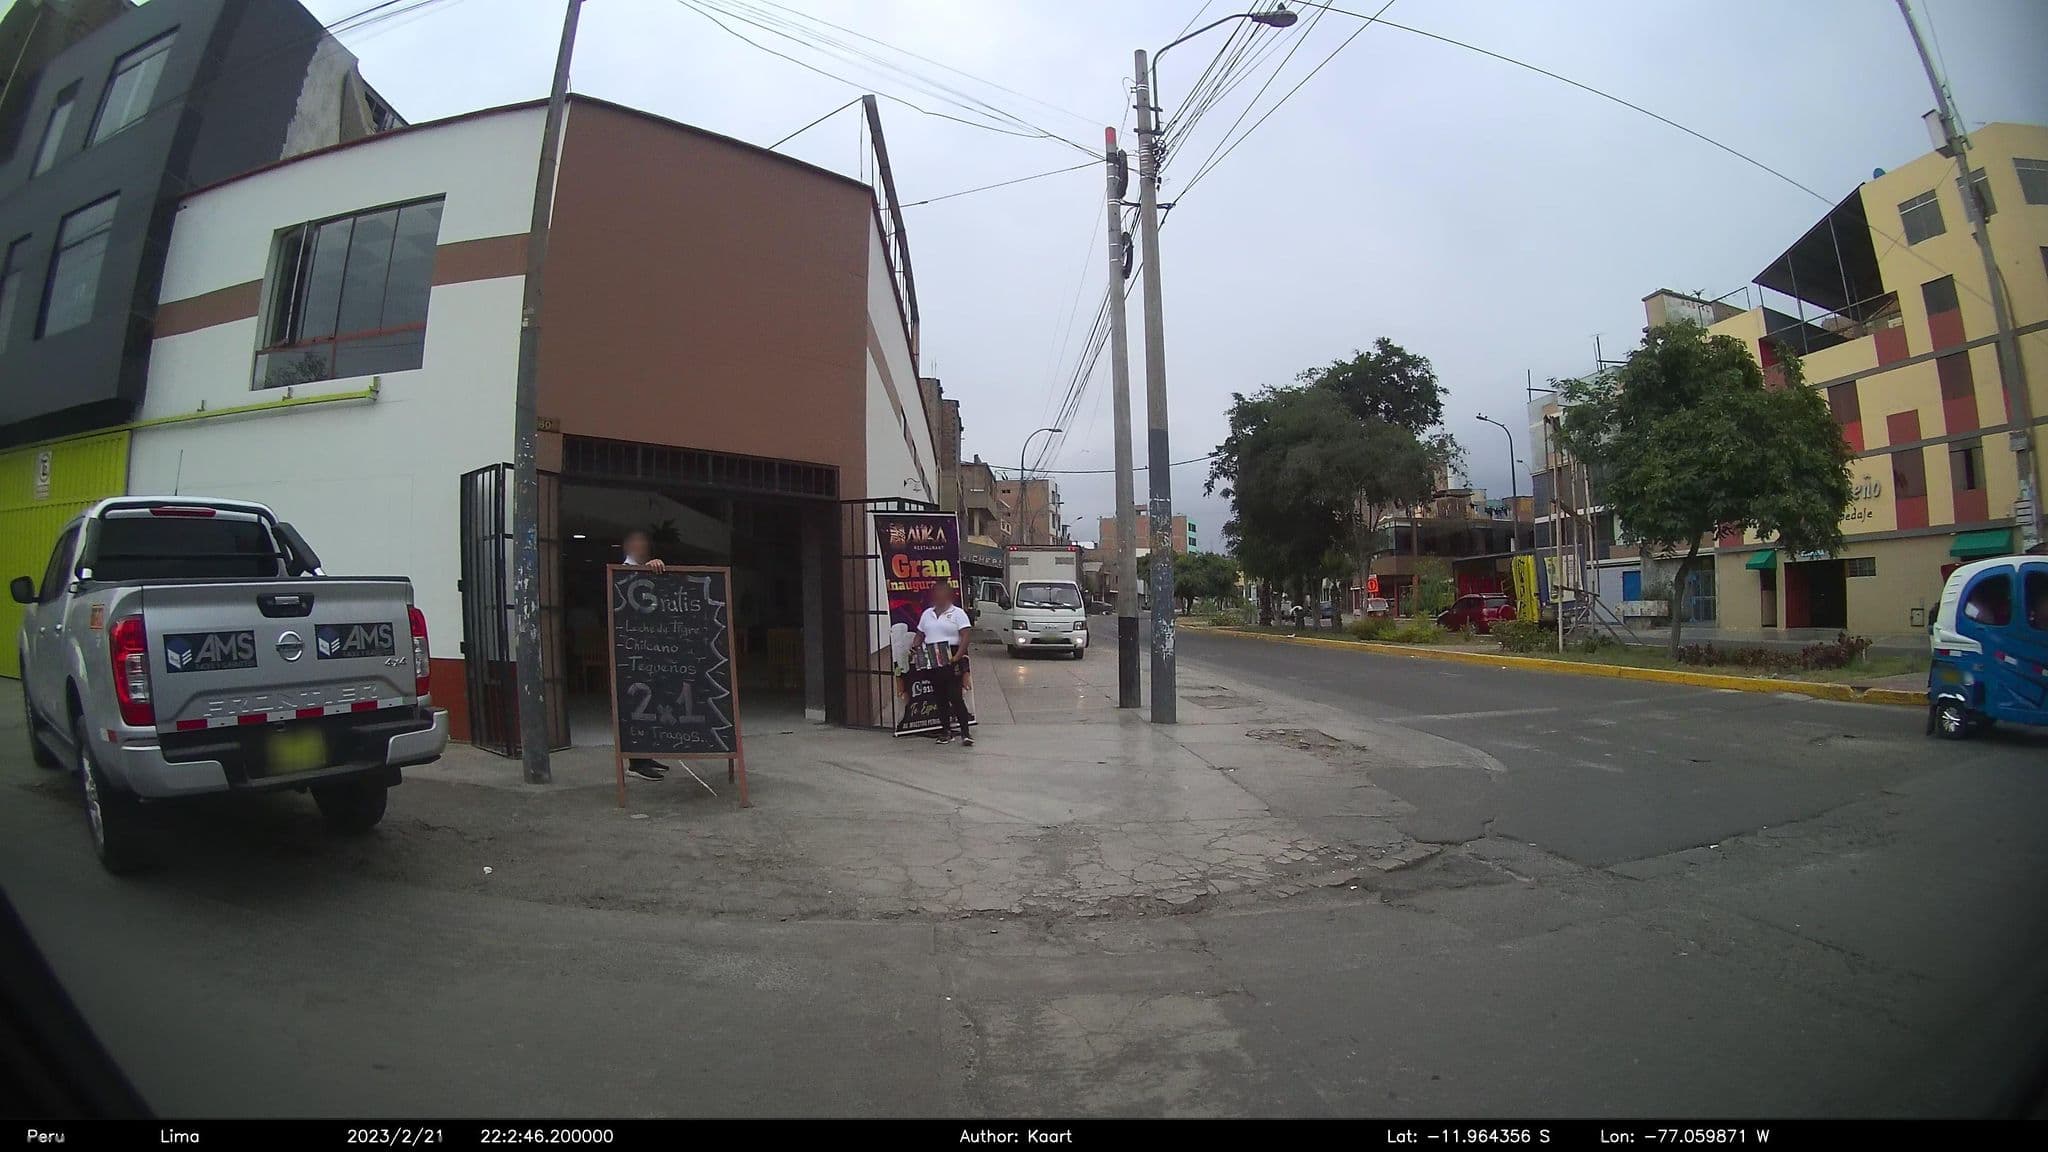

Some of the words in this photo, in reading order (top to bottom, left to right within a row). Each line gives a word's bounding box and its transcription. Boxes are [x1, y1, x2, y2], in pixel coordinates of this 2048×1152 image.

[891, 554, 951, 579] Gran
[627, 579, 701, 613] Gratis
[195, 634, 257, 662] AMS
[341, 624, 393, 650] AMS
